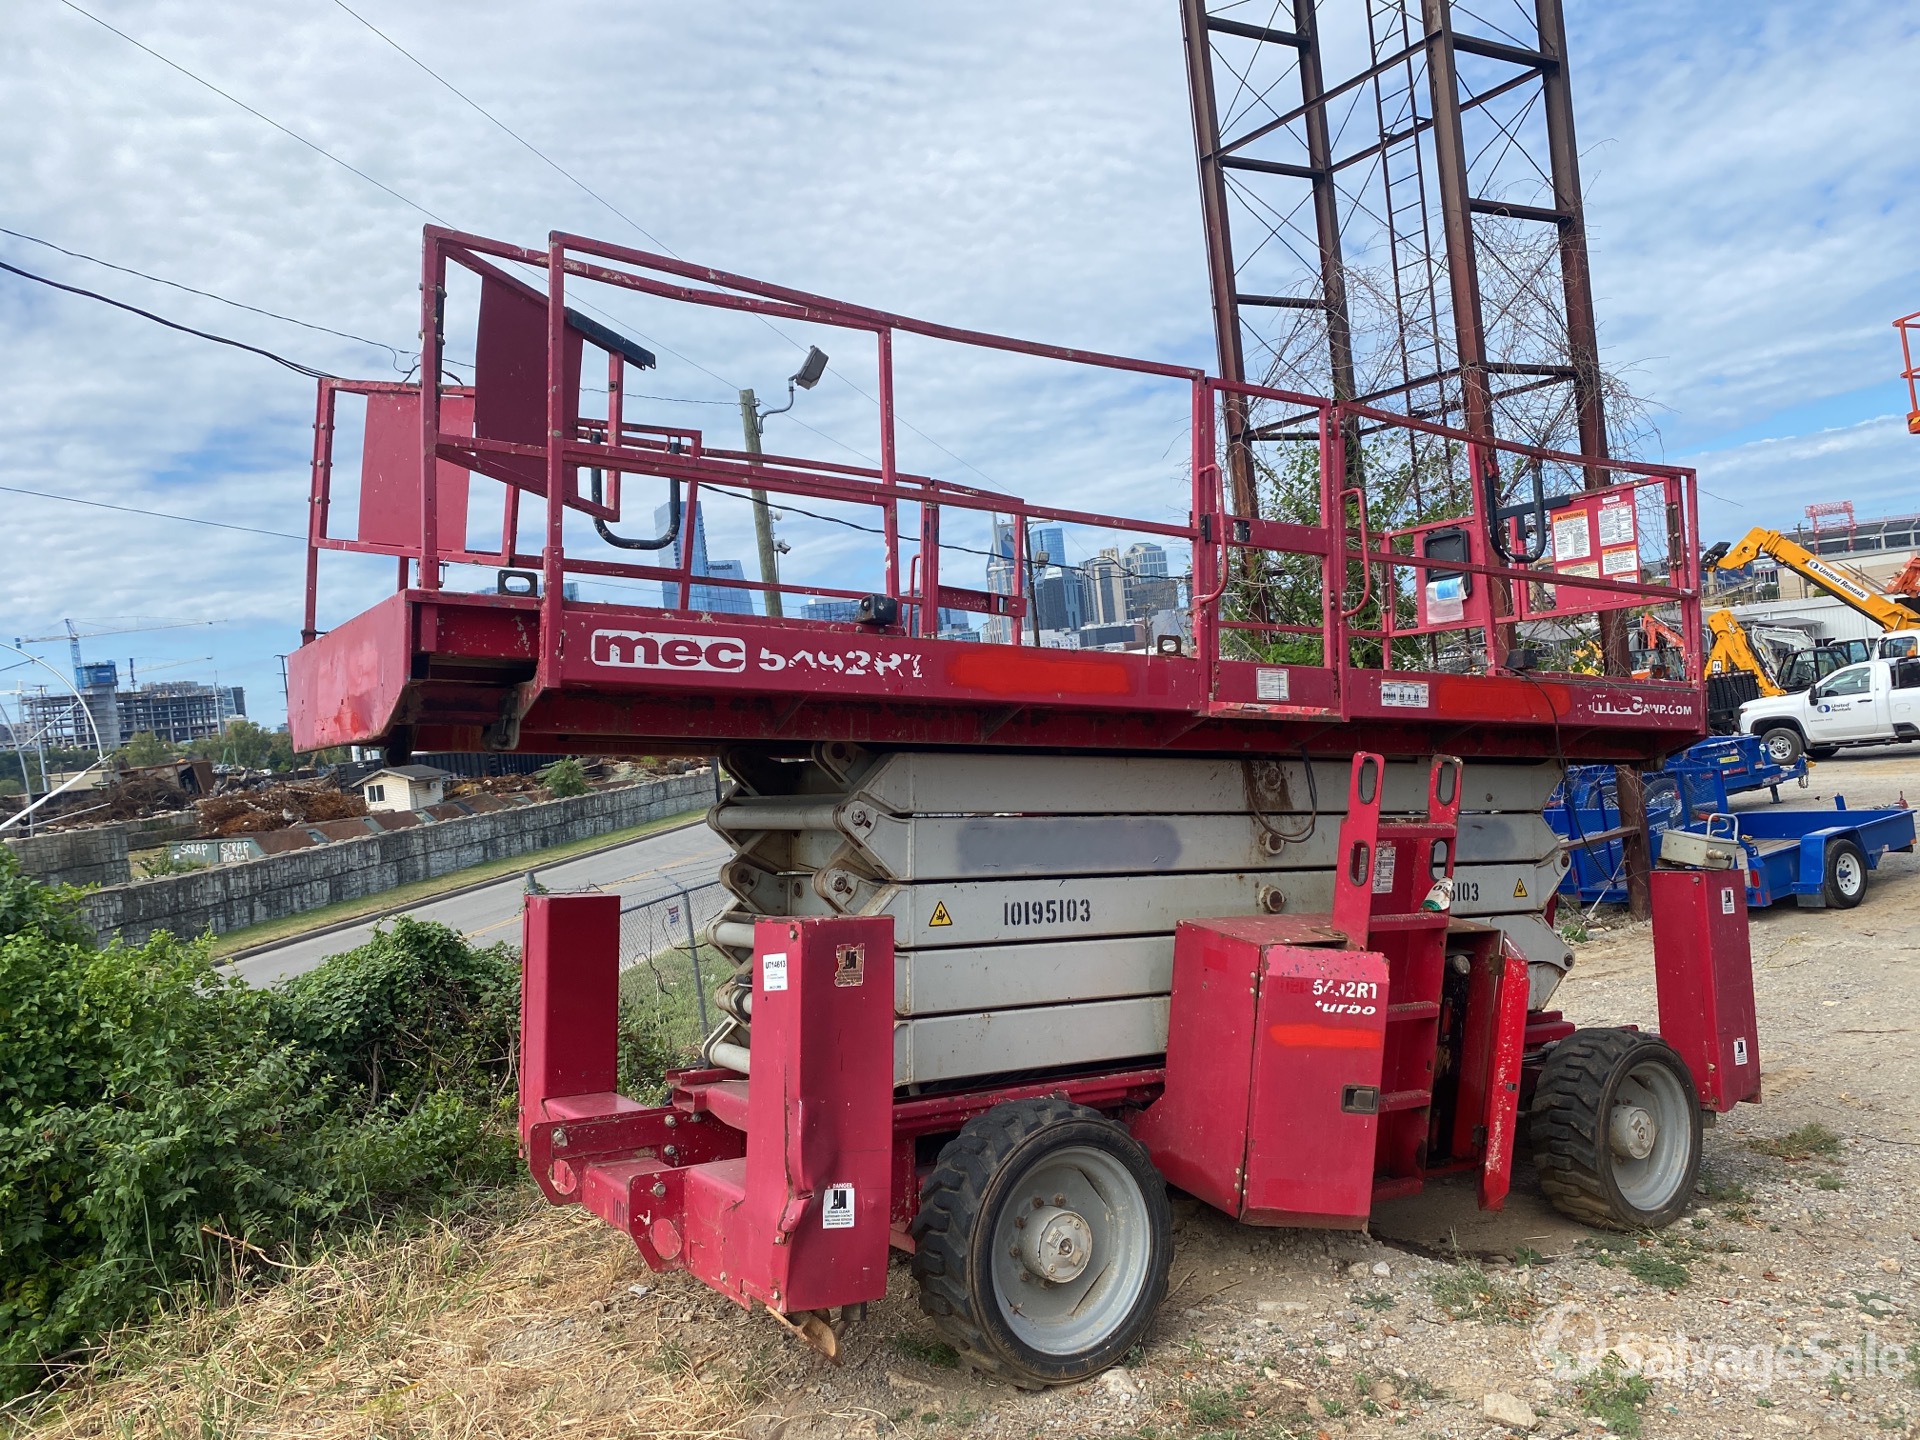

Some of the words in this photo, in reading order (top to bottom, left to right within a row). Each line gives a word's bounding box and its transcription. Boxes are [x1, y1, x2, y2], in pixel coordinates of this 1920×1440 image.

[1818, 566, 1841, 585] United
[1841, 580, 1866, 599] Rentals
[594, 634, 745, 669] mec
[180, 843, 208, 856] SCRAP
[220, 842, 249, 855] SCRAP
[1003, 899, 1091, 926] 10195103
[1314, 1000, 1377, 1015] turbo
